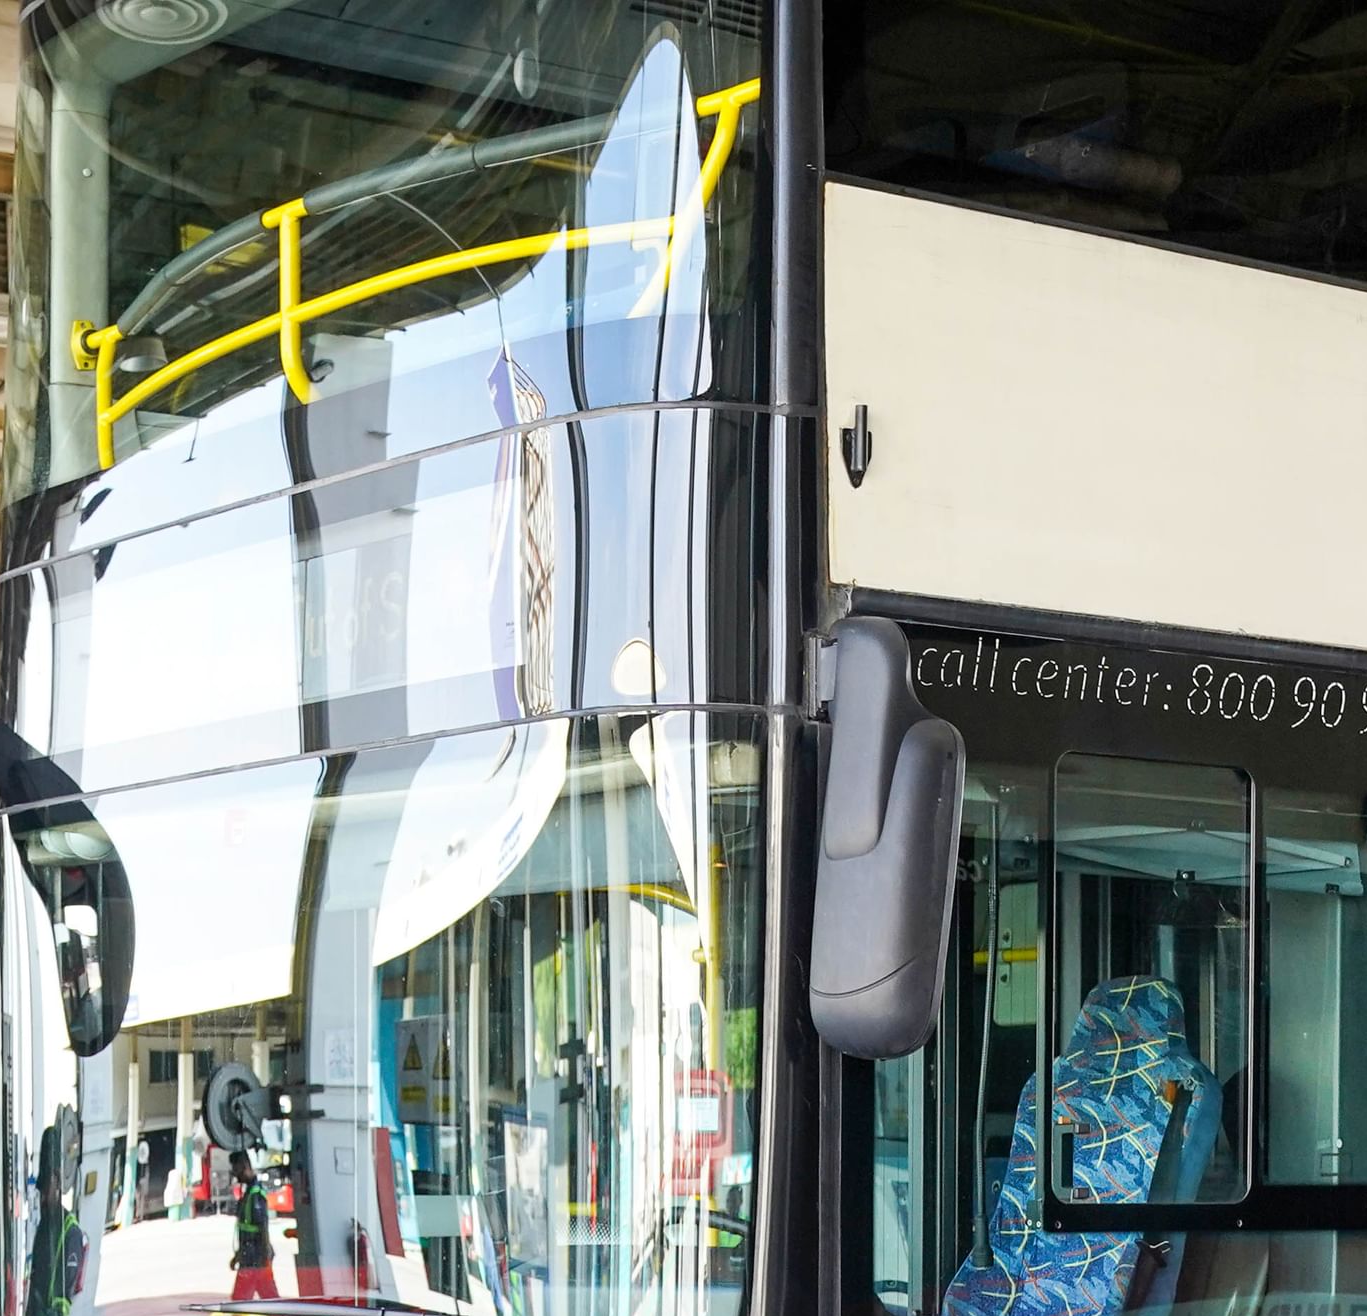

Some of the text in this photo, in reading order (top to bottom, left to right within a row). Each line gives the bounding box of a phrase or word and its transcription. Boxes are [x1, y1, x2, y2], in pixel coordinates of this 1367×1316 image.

[916, 637, 1001, 694] call
[1011, 656, 1173, 711] center:
[1186, 664, 1276, 721] 800
[1291, 677, 1346, 728] 90
